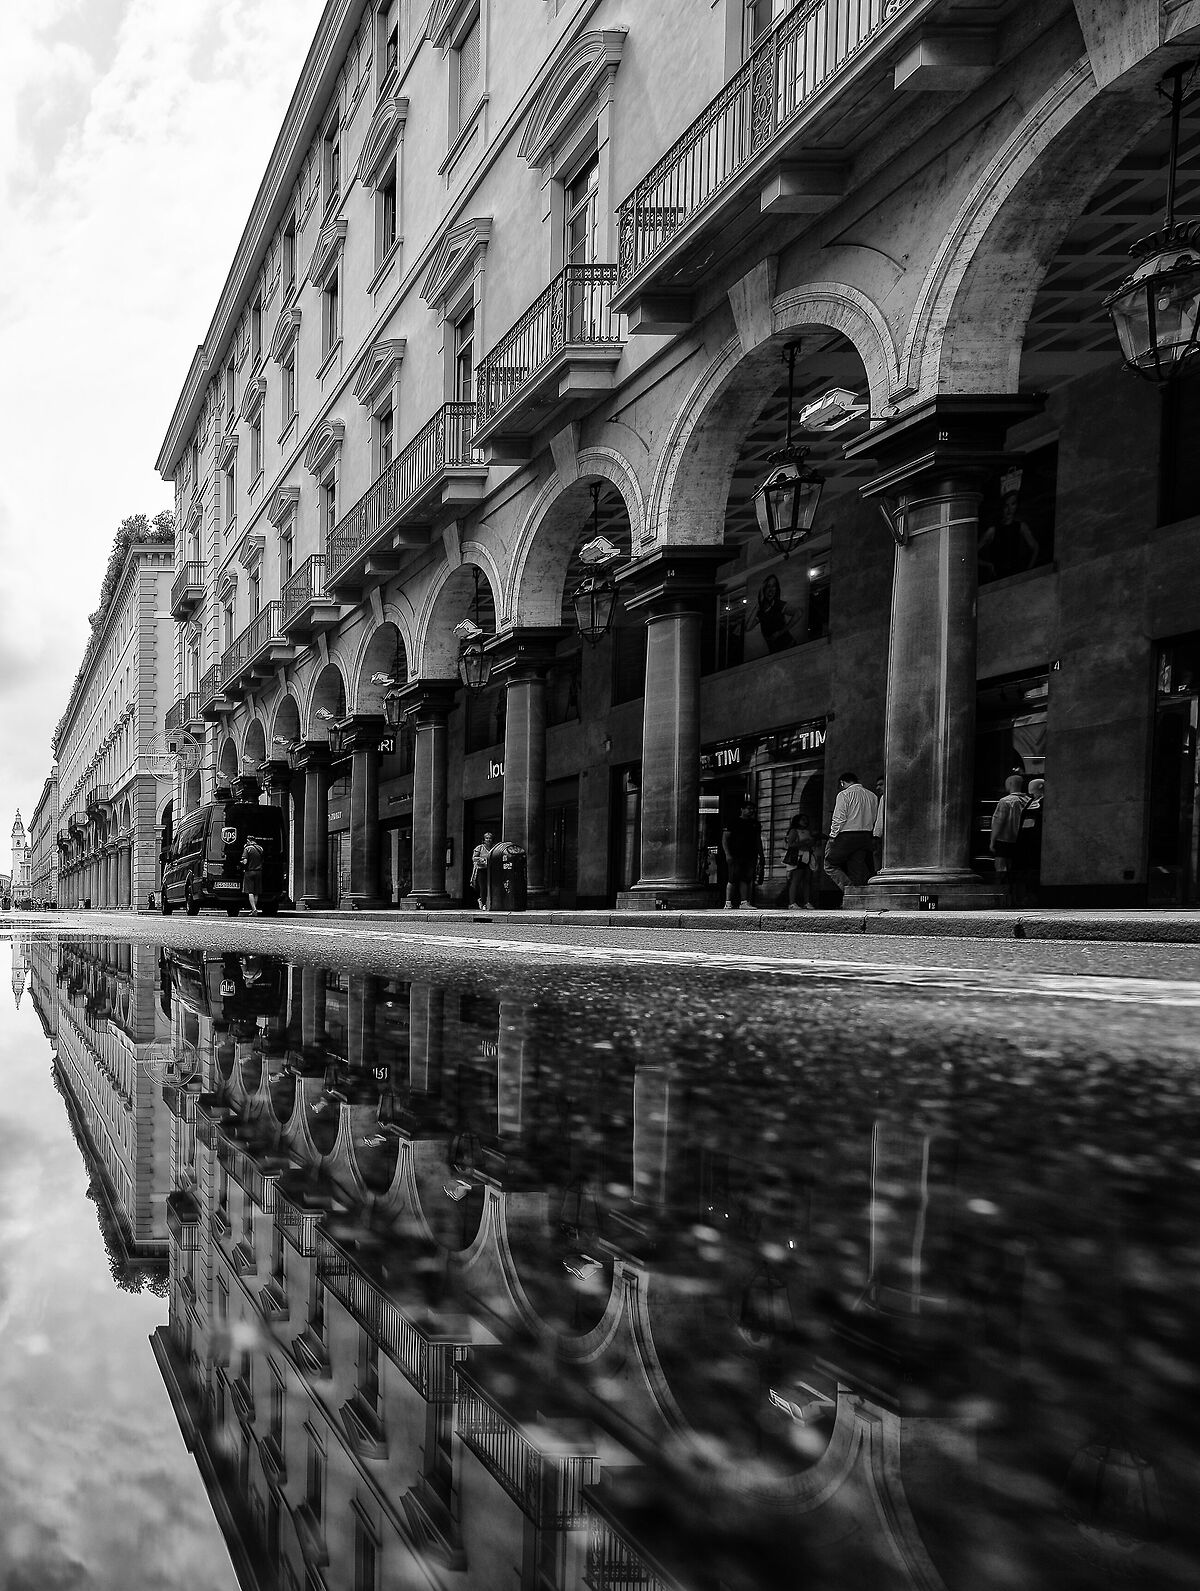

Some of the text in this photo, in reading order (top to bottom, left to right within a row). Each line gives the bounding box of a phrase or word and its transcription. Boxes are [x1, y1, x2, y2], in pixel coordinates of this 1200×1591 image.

[938, 431, 949, 441] 12
[800, 730, 827, 750] TIM
[715, 748, 740, 767] TIM
